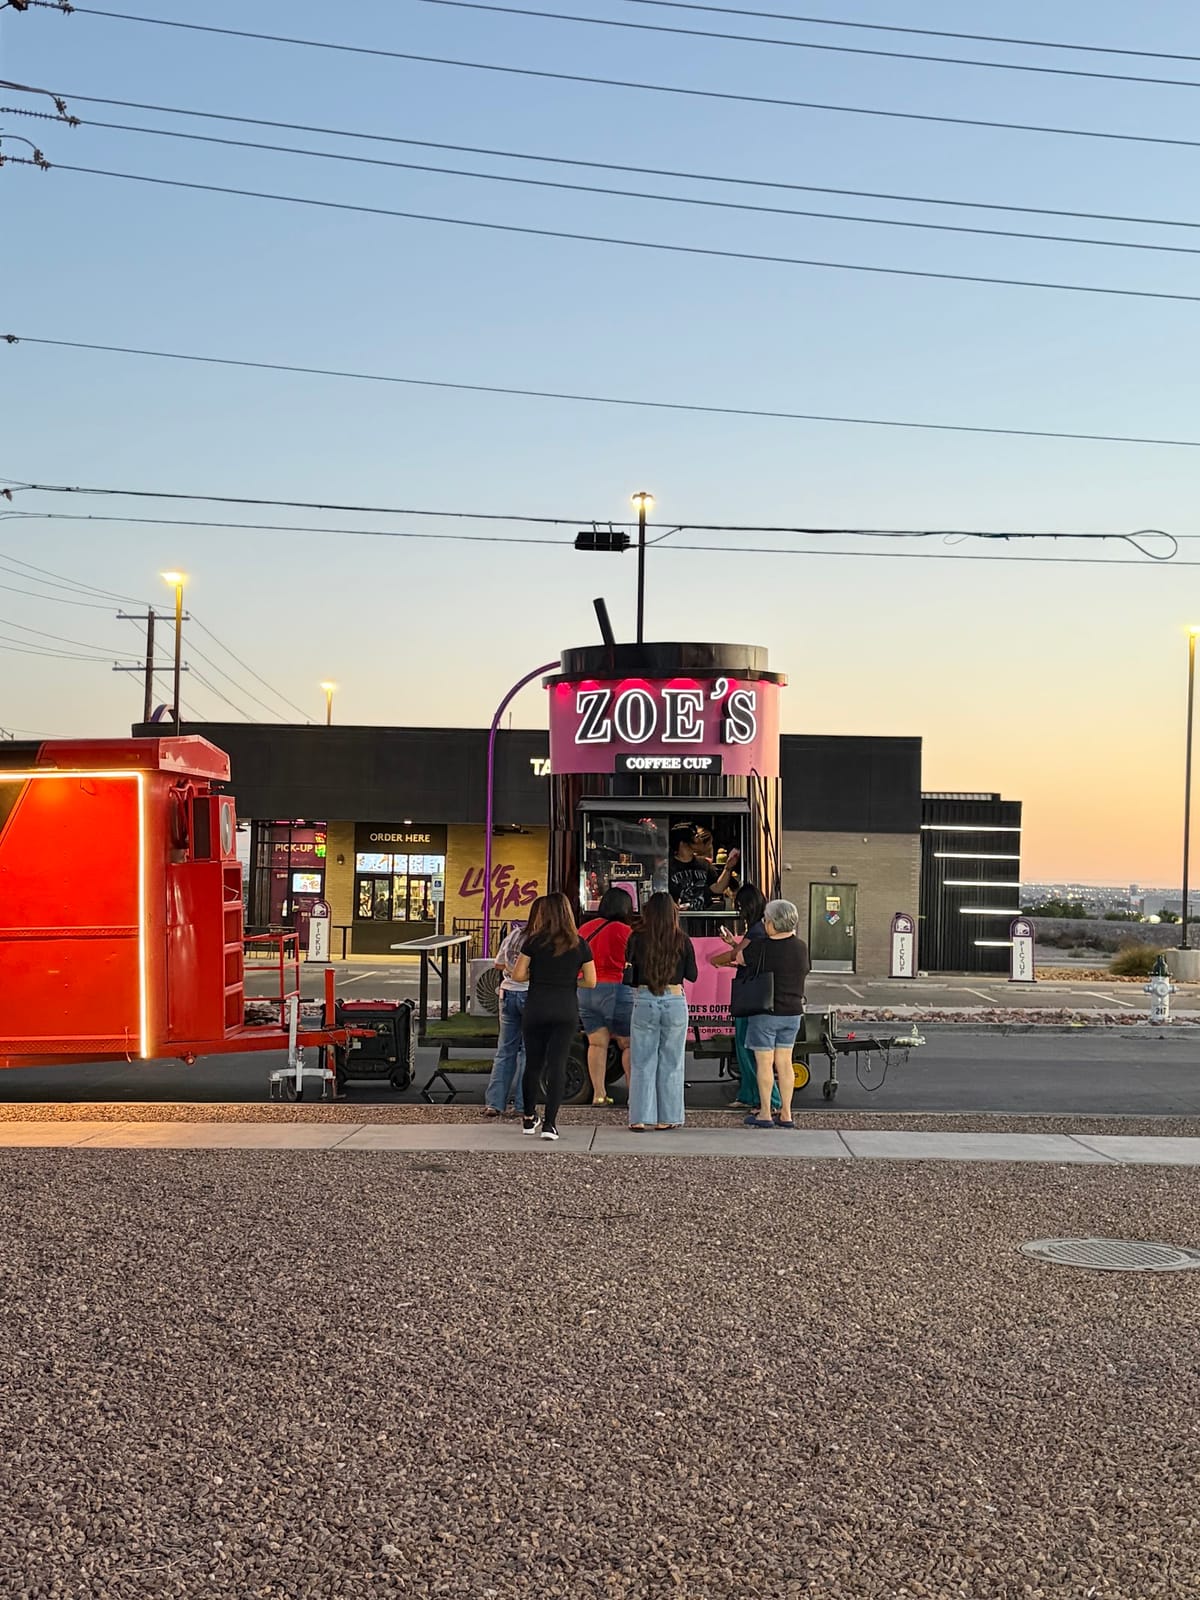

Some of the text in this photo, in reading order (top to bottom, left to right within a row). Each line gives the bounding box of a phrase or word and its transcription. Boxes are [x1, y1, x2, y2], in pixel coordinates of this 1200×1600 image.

[575, 677, 757, 745] ZOE'S
[626, 757, 712, 769] COFFEE CUP
[370, 832, 431, 843] ORDER HERE
[275, 843, 313, 852] PICK-UP
